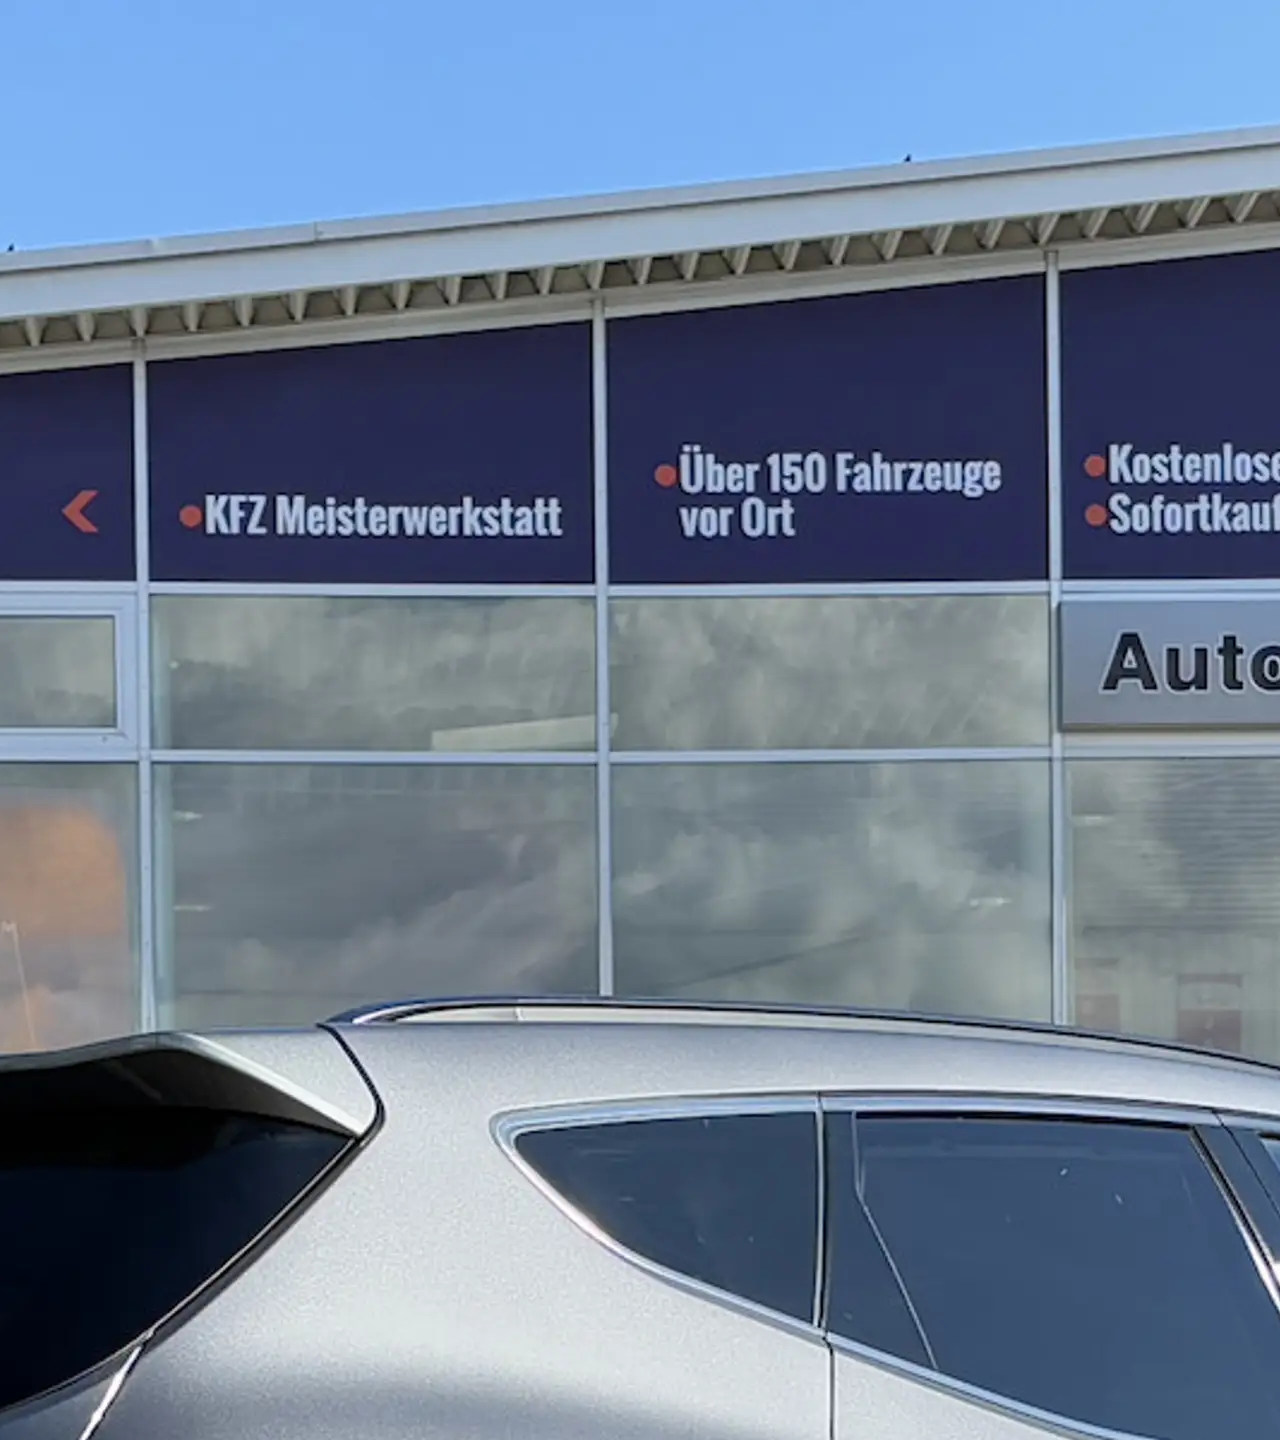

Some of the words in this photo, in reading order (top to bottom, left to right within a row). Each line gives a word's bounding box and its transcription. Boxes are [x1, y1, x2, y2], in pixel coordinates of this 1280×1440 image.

[679, 444, 760, 494] Über
[766, 451, 827, 493] 150
[835, 451, 1002, 499] Fahrzeuge
[205, 494, 268, 536] KFZ
[276, 494, 563, 537] Meisterwerkstatt
[679, 506, 734, 538] vor
[742, 496, 796, 538] Ort
